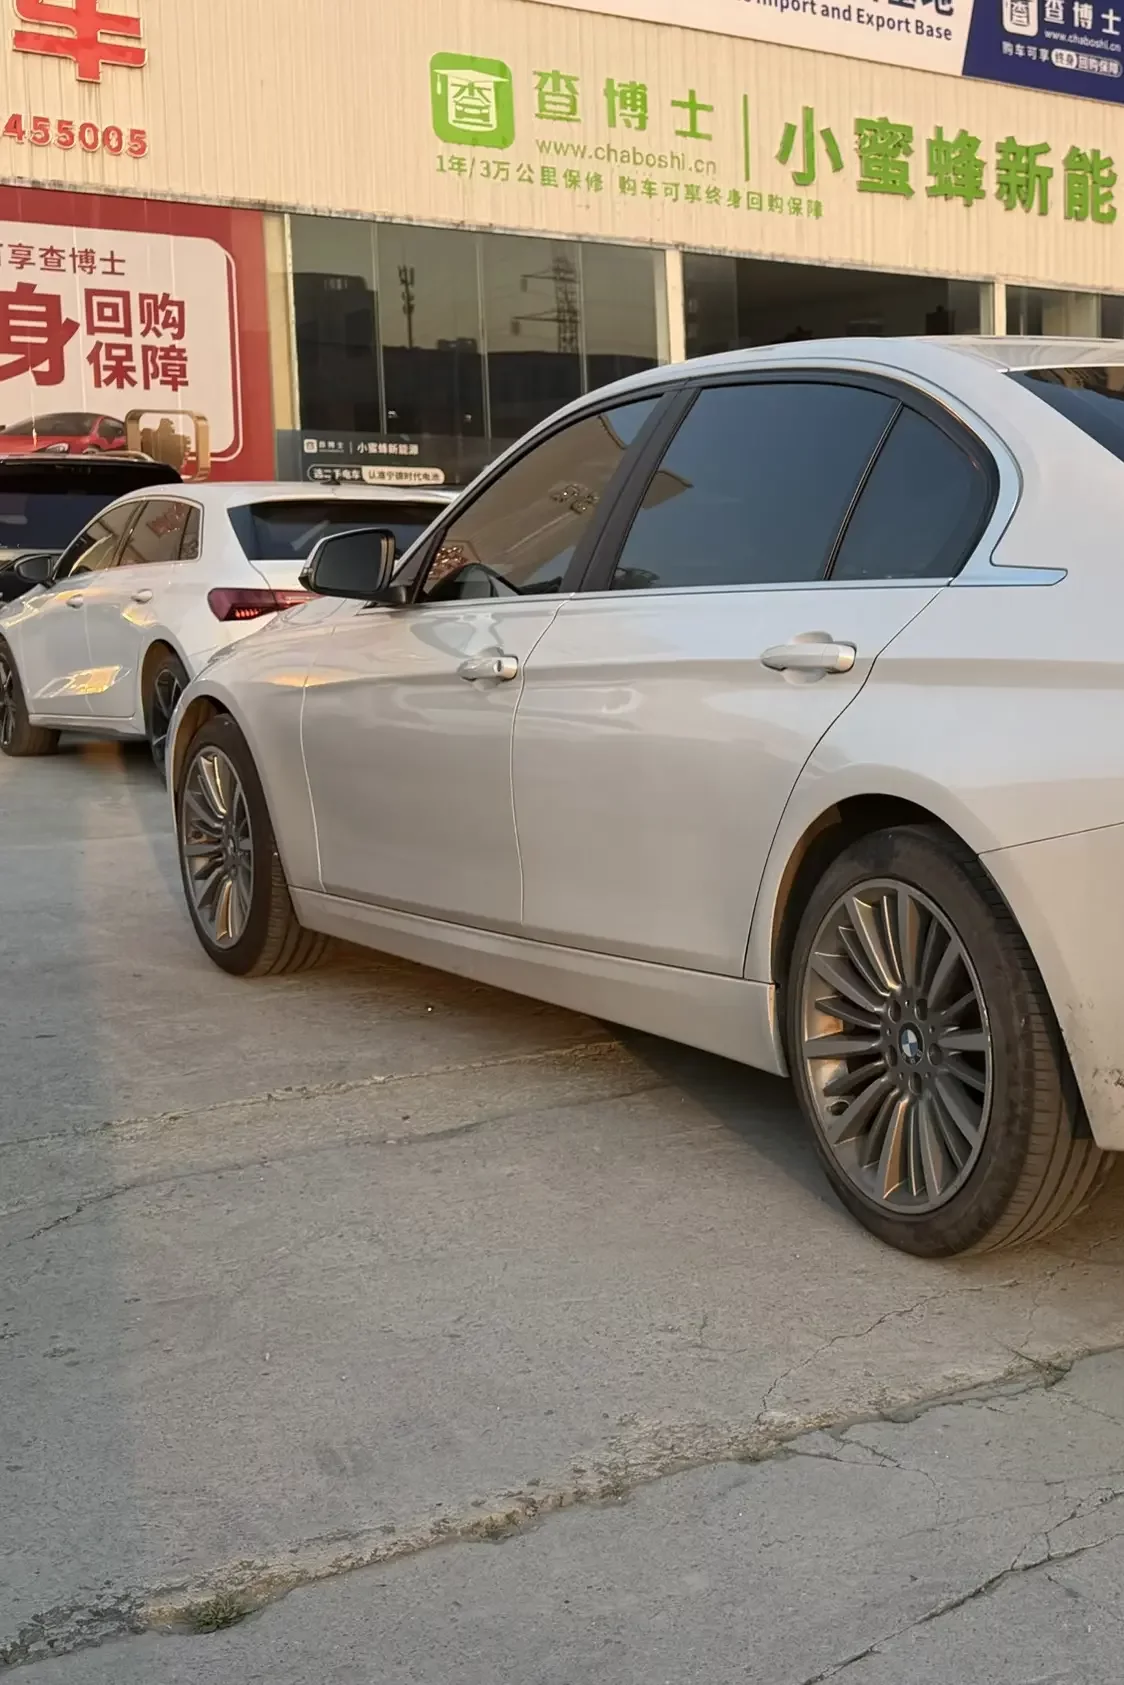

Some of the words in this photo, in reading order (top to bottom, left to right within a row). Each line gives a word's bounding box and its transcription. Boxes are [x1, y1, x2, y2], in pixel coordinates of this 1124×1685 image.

[757, 0, 816, 15] port
[821, 3, 852, 21] and
[857, 8, 911, 34] Export
[916, 19, 952, 41] Base
[1044, 0, 1121, 36] 查博士
[532, 69, 714, 142] 查博士
[3, 113, 148, 158] 455005
[535, 137, 717, 176] www.chaboshi.cn
[436, 154, 604, 193] 1年/3万公里保修
[618, 175, 824, 219] 购车可享终身回购保障
[0, 242, 126, 276] 享查博士
[84, 288, 186, 341] 回购
[86, 340, 189, 392] 保障
